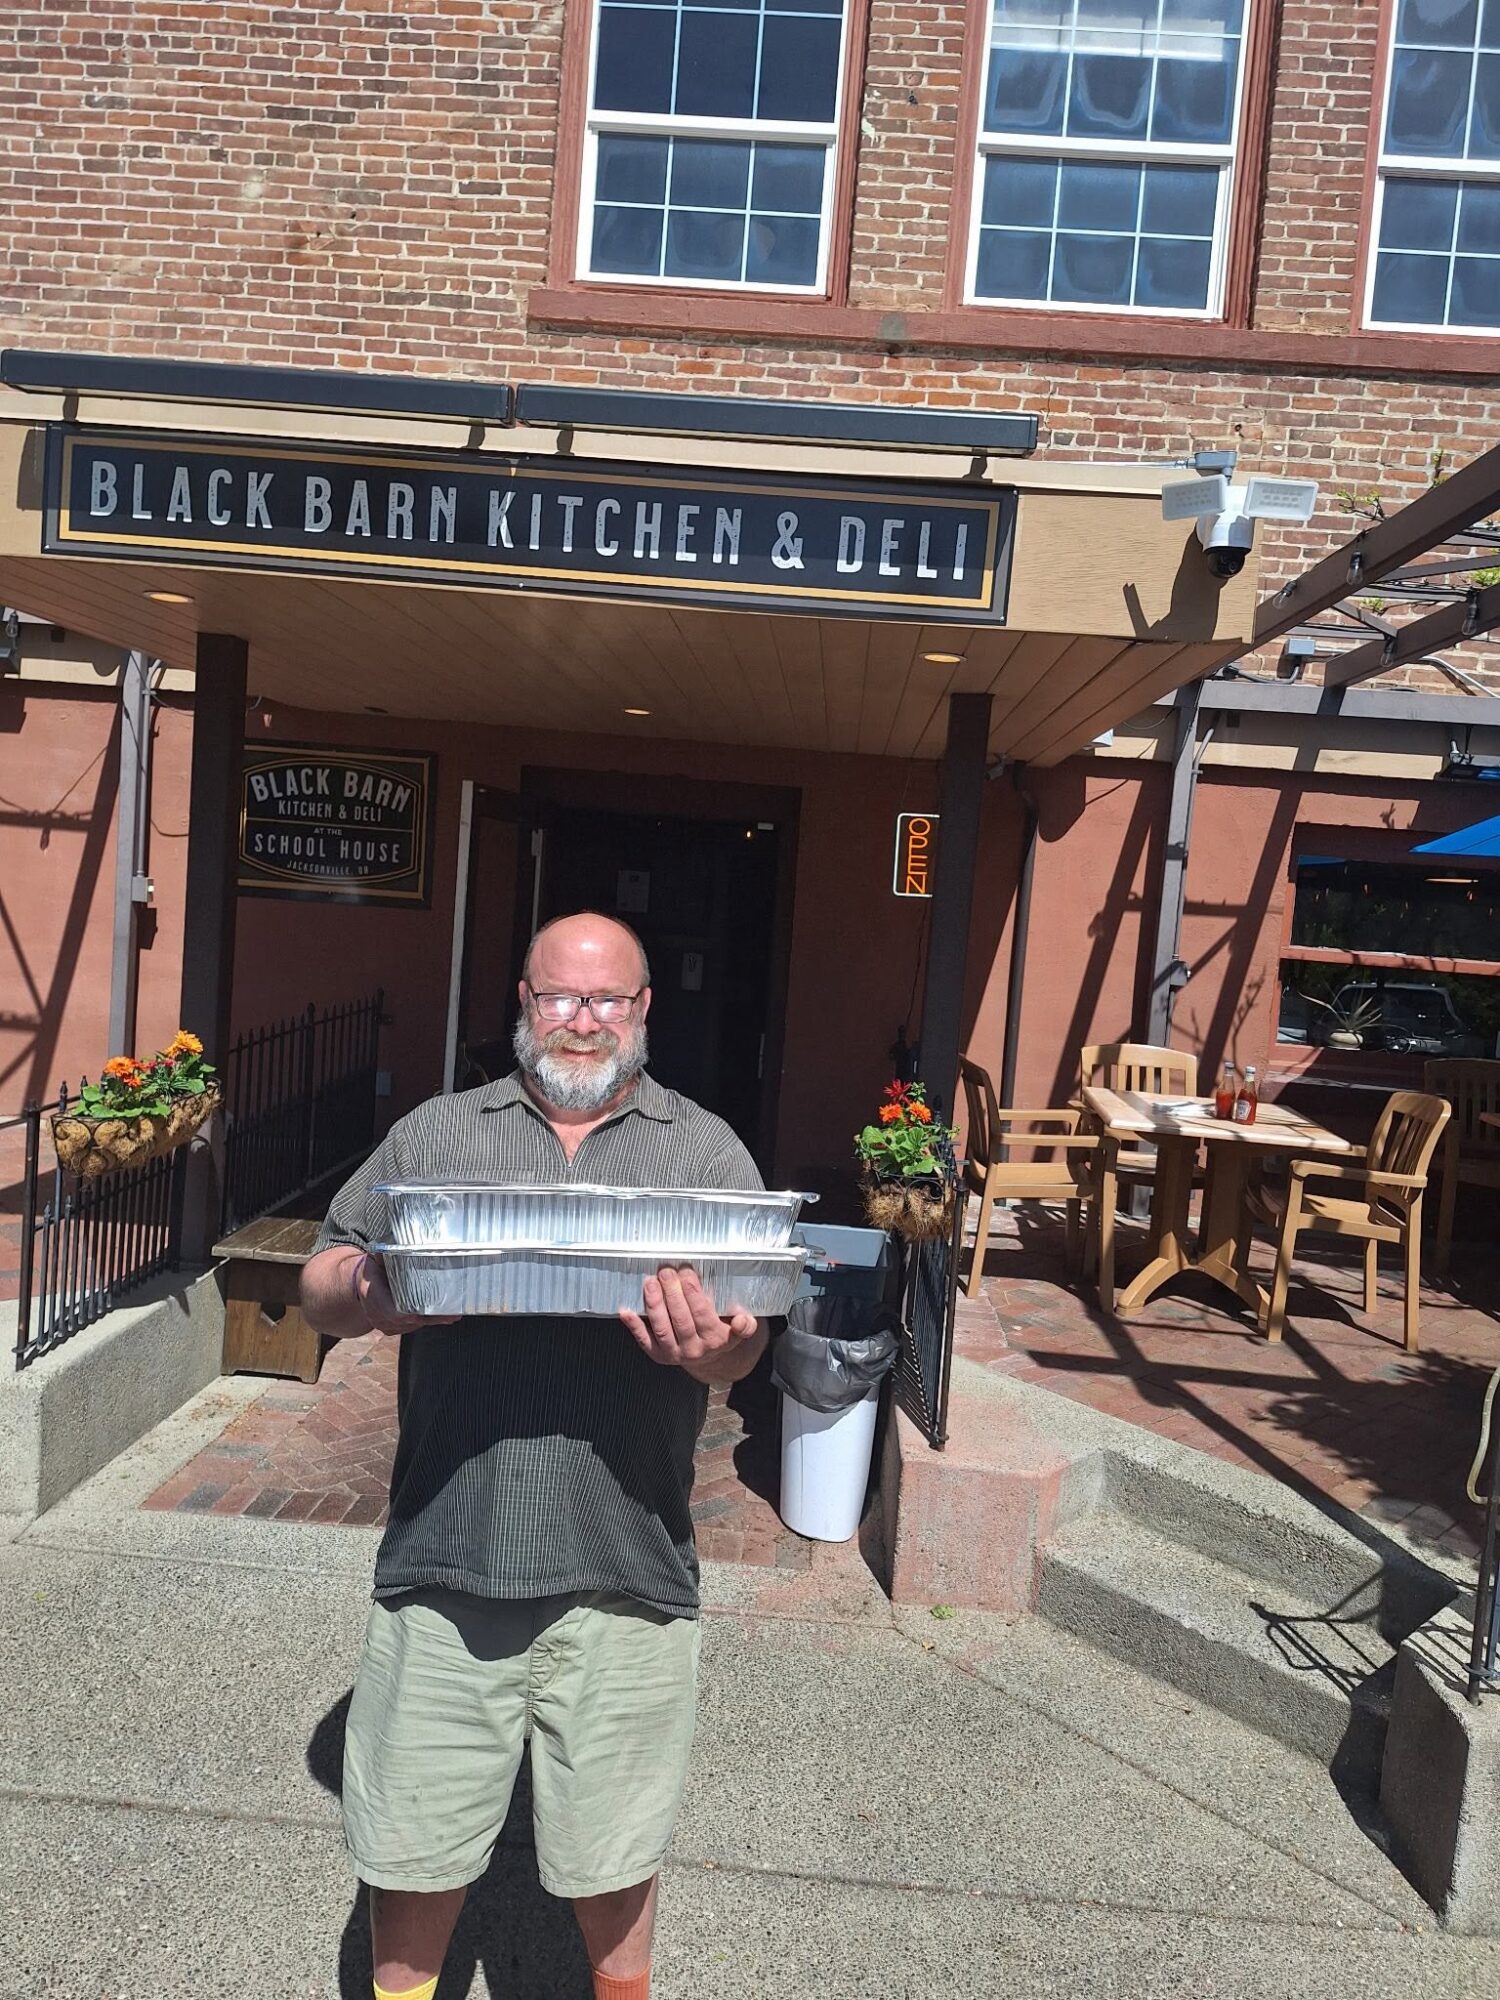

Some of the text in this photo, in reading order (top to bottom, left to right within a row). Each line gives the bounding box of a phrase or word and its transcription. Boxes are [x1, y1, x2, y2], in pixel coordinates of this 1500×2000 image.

[89, 460, 969, 581] BLACK BARN KITCHEN & DELI
[250, 767, 412, 813] BLACK BARN
[278, 800, 382, 822] KITCHEN & DELI
[313, 827, 343, 836] AT THE
[254, 833, 401, 863] SCHOOL HOUSE
[905, 817, 931, 896] OPEN
[357, 865, 369, 875] OR
